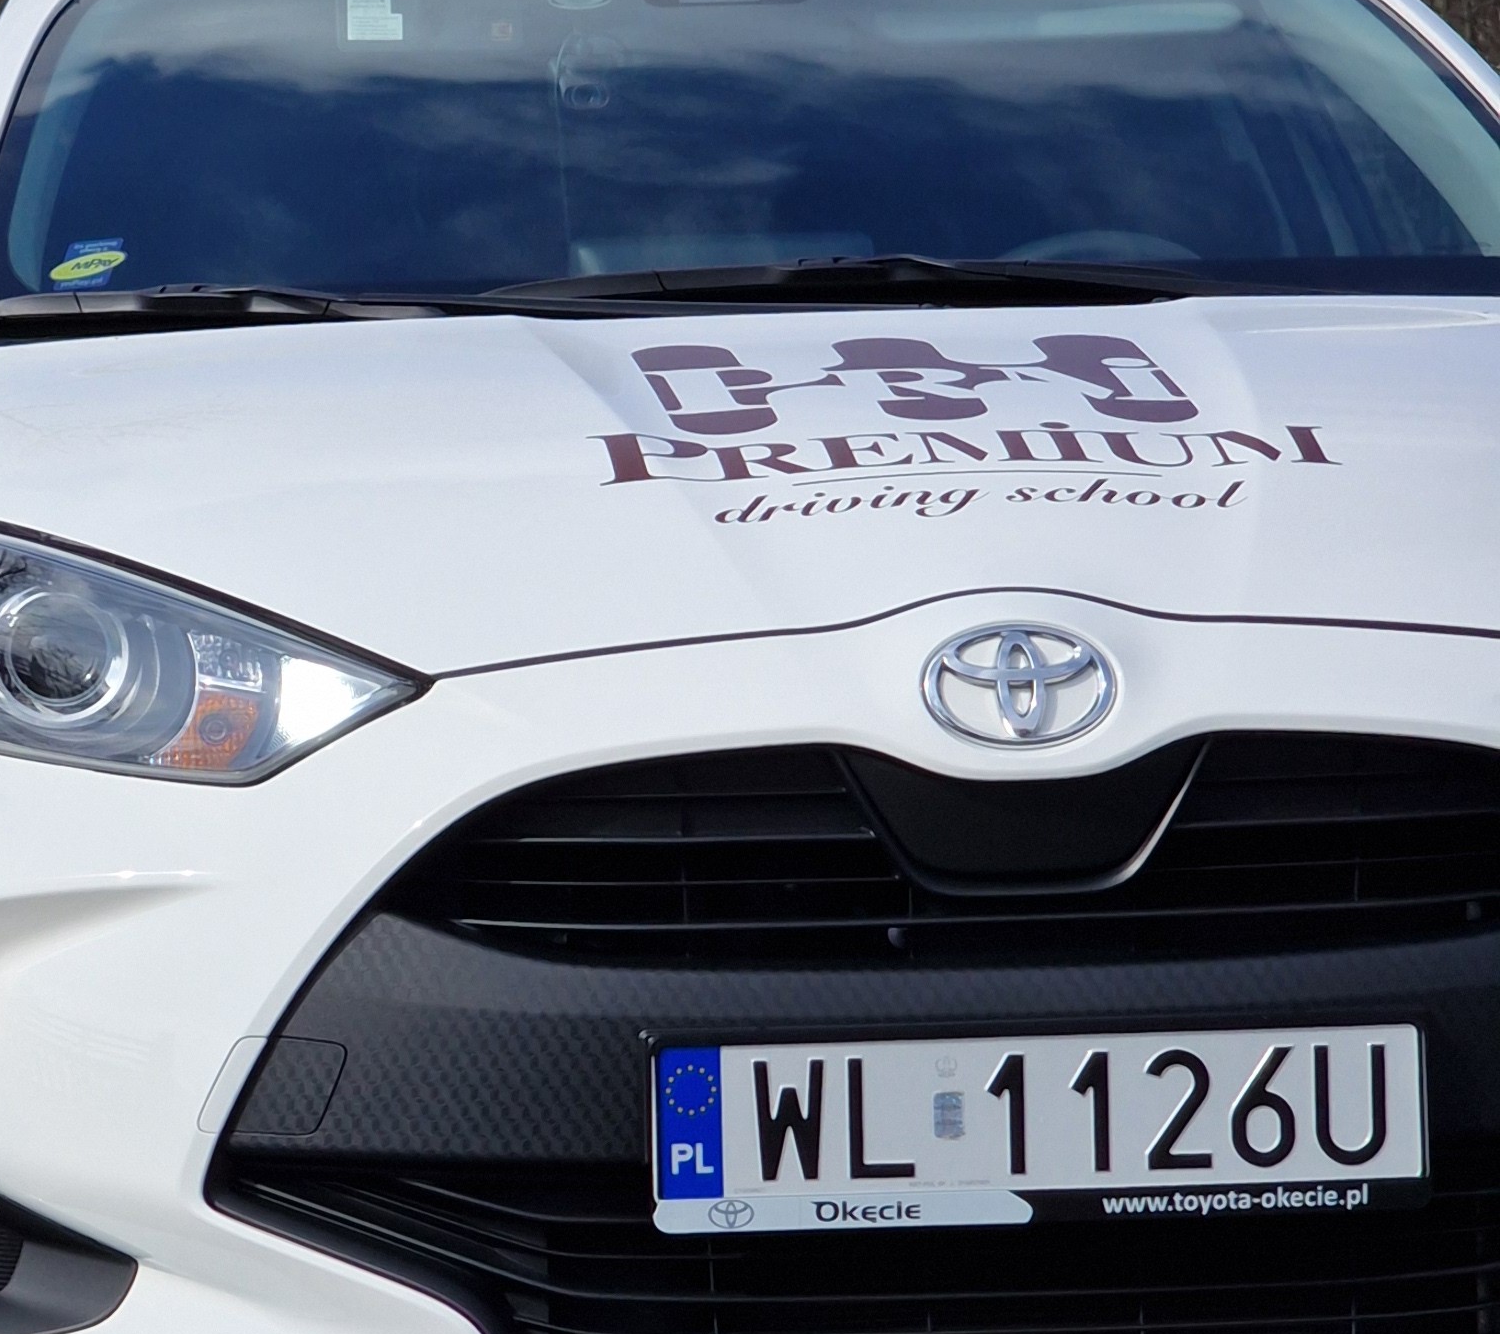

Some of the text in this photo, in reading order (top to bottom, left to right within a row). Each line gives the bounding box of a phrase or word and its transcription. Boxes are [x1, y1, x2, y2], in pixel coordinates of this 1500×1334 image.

[713, 478, 1249, 525] driving school
[752, 1042, 1389, 1182] WL 1126U
[670, 1142, 714, 1175] PL
[1101, 1183, 1370, 1216] www.toyota-okecie.pl
